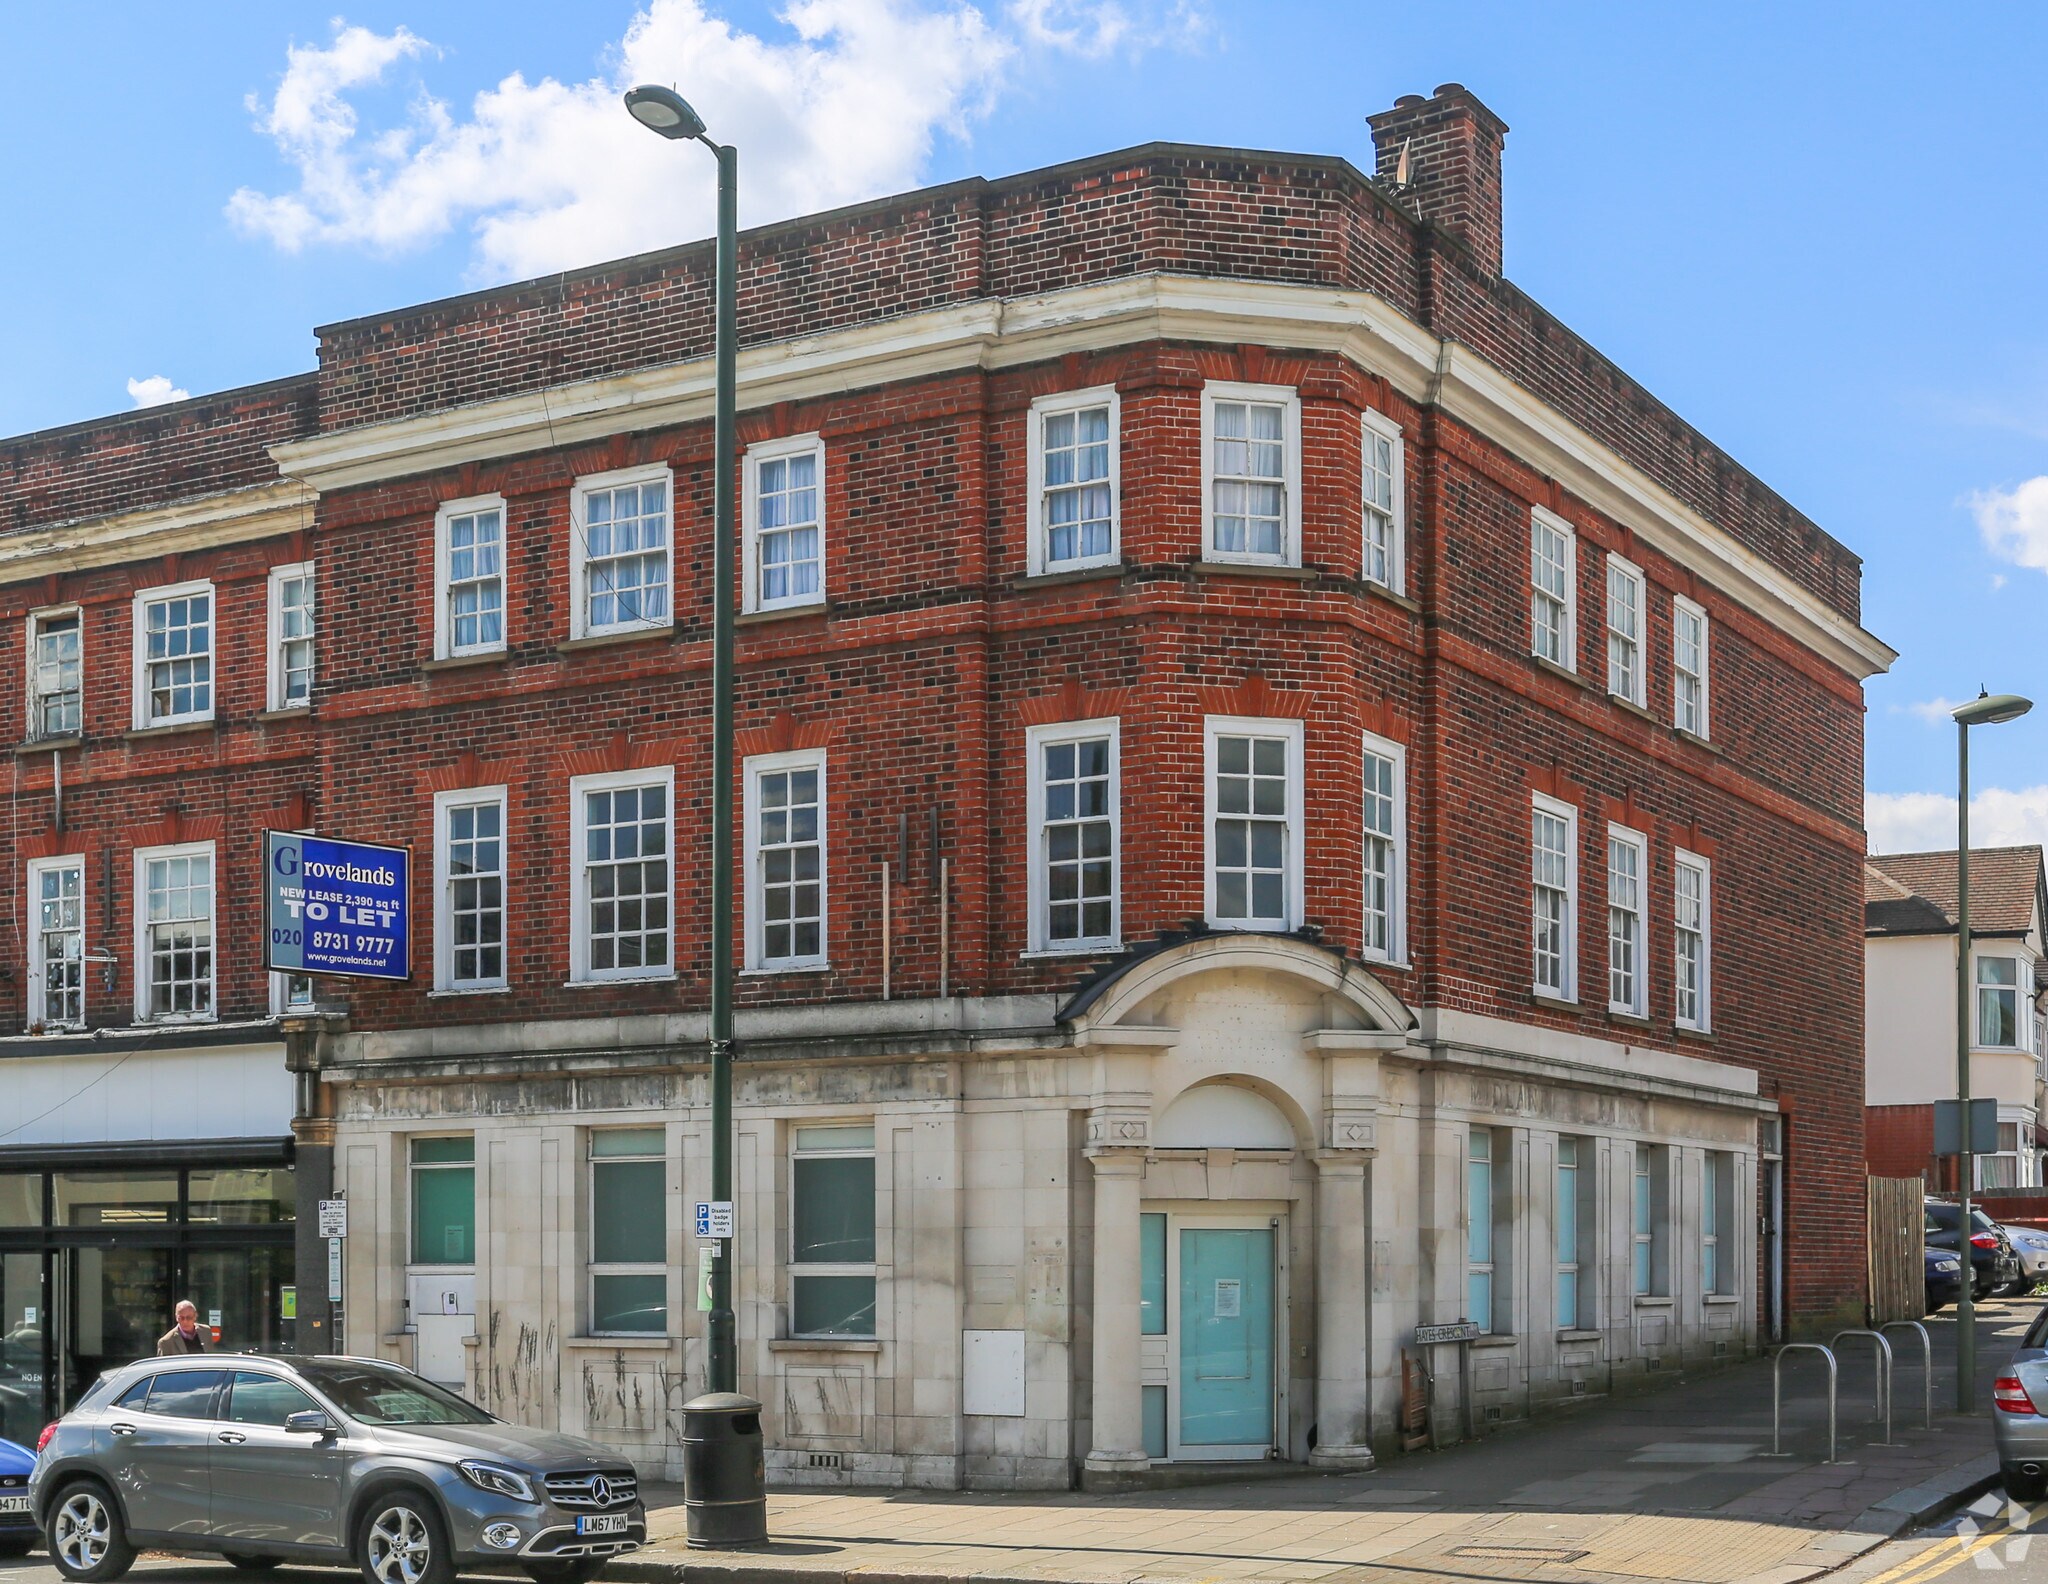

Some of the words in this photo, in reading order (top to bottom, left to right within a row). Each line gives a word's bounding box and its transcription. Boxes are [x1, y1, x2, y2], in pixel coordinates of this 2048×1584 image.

[274, 846, 394, 887] Grovelands
[280, 887, 305, 899] NEW
[309, 890, 343, 903] LEASE
[345, 895, 373, 906] 2,390
[376, 900, 388, 910] sq
[391, 899, 399, 910] ft
[284, 899, 329, 921] TO
[339, 906, 396, 928] LET
[272, 928, 302, 945] 020
[313, 931, 349, 950] 8731
[356, 936, 394, 954] 9777
[307, 953, 387, 967] www.grovelands.net
[699, 1206, 707, 1217] P
[1417, 1327, 1435, 1342] HAYES
[21, 1373, 32, 1382] NO
[584, 1517, 610, 1532] LM67
[612, 1516, 627, 1530] YHN
